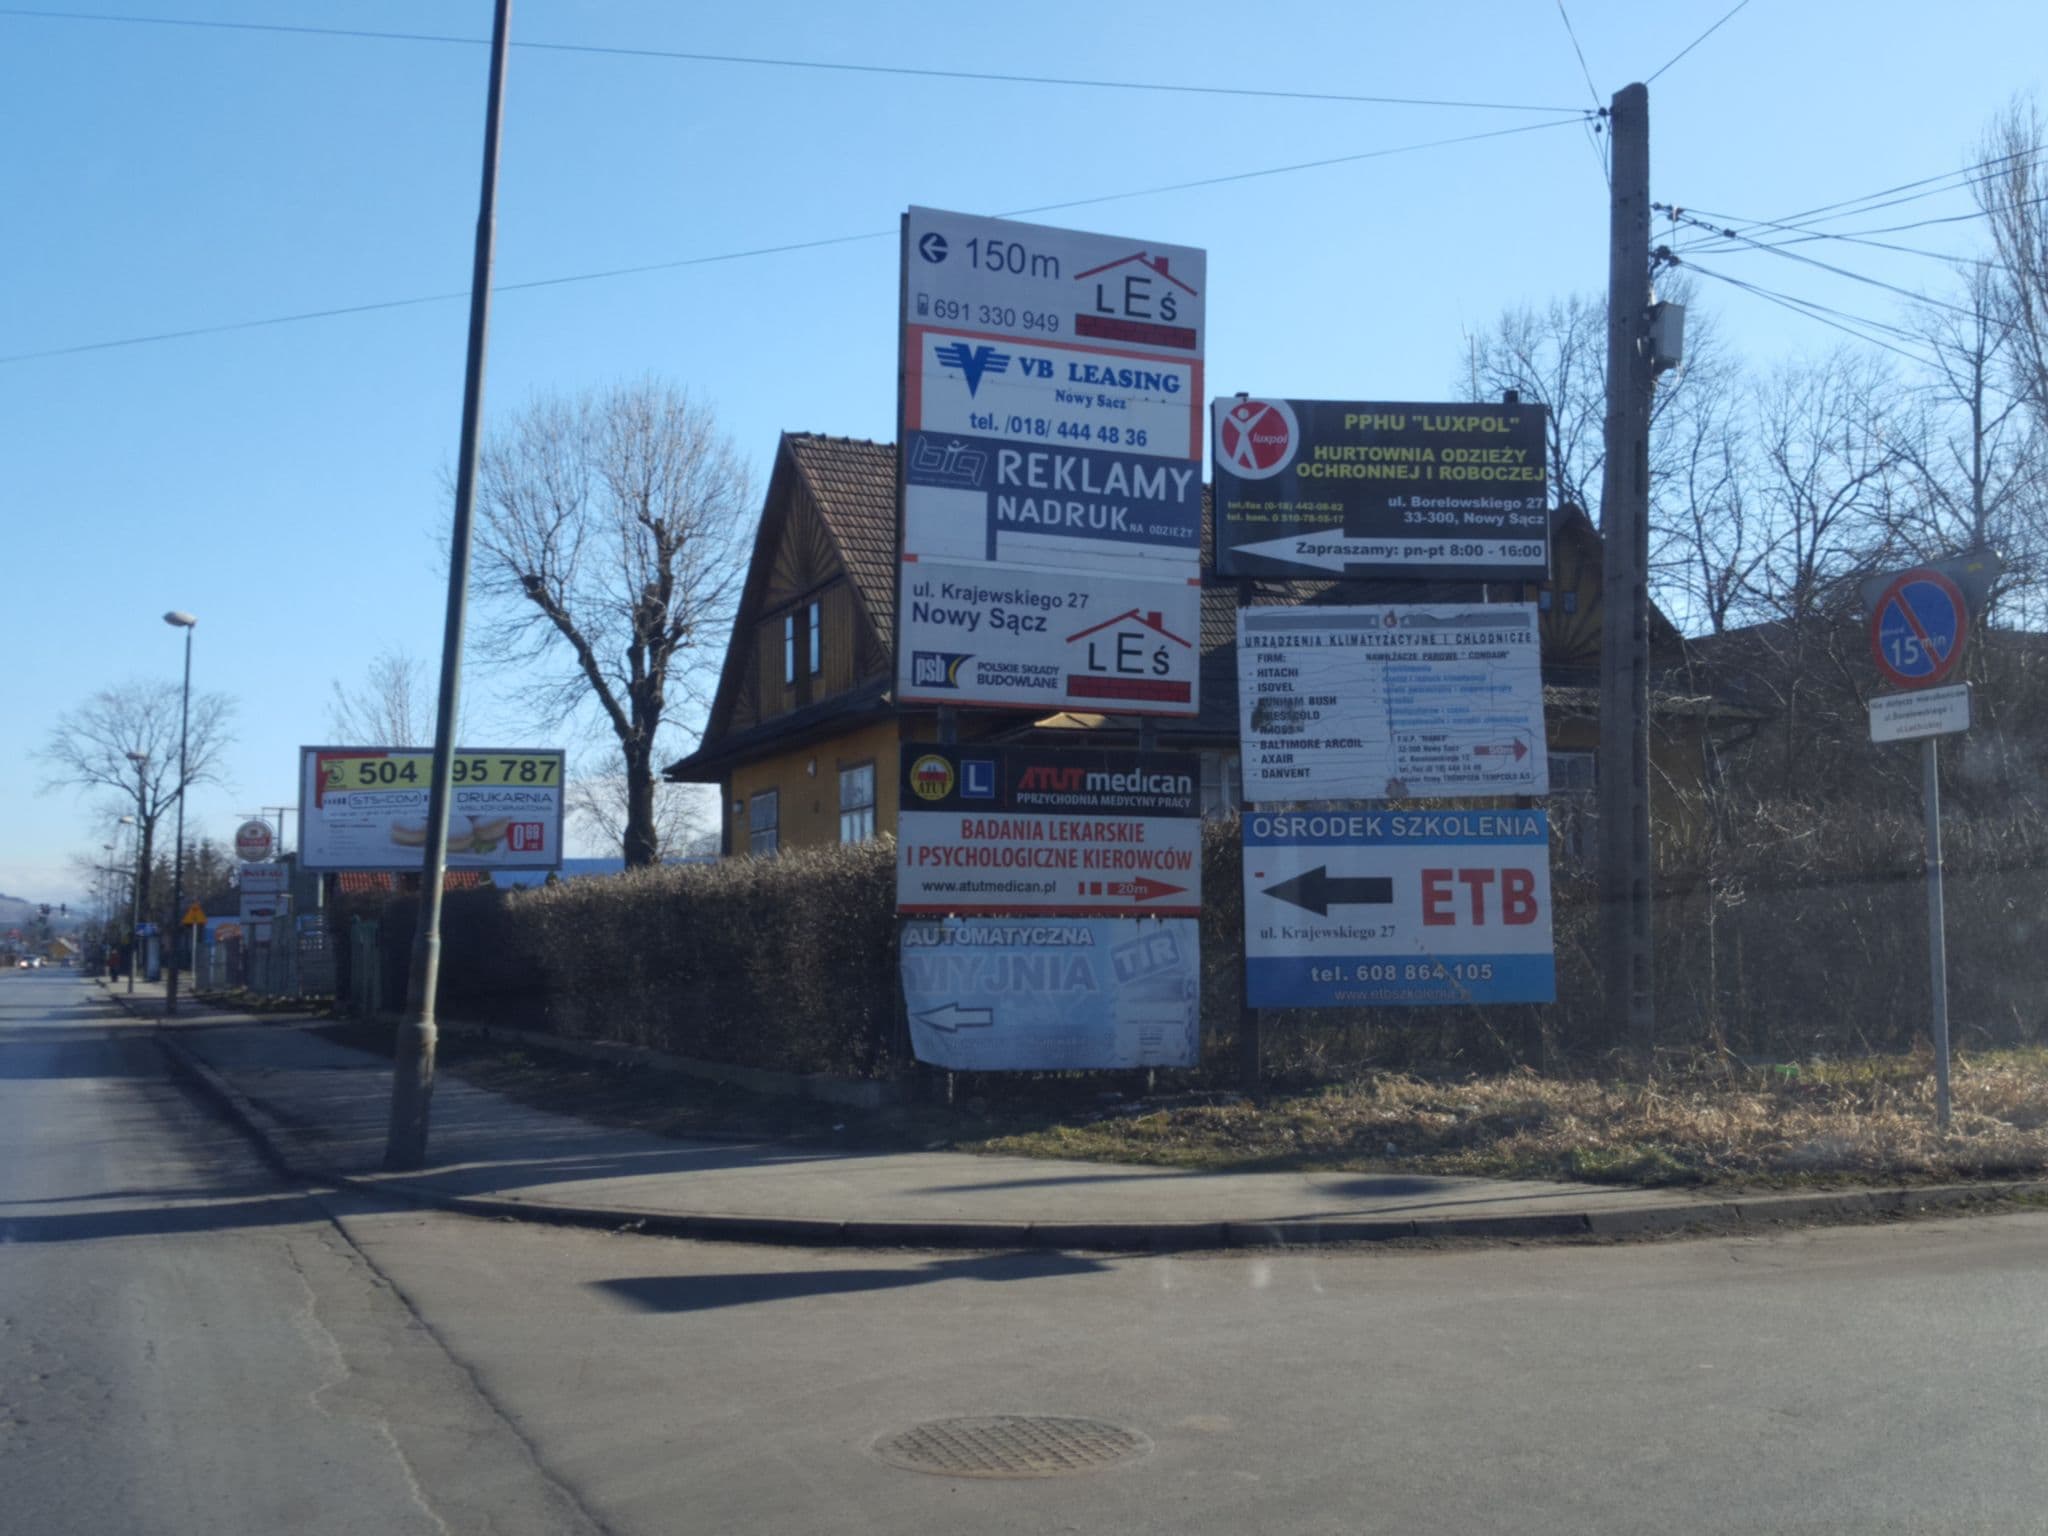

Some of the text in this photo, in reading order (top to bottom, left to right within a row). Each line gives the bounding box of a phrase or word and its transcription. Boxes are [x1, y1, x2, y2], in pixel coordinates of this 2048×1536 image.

[1096, 275, 1178, 322] LEŚ
[934, 299, 1060, 333] 691 330 949
[1019, 356, 1181, 394] VB LEASING
[1055, 389, 1093, 409] Nowy
[970, 412, 1148, 447] tel. /018/ 444 48 36
[1344, 413, 1520, 433] PPHU "LUXPOL"
[1252, 431, 1288, 446] luxpol
[1314, 445, 1527, 465] HURTOWNIA ODZIEŻY
[997, 449, 1193, 503] REKLAMY
[1296, 463, 1544, 481] OCHRONNEJ I ROBOCZEJ
[1388, 495, 1544, 511] ul. Borelowskiego 27
[997, 496, 1129, 532] NADRUK
[1129, 522, 1144, 534] NA
[1404, 512, 1545, 528] 33-300, Nowy Sącz
[1296, 541, 1399, 558] Zapraszamy:
[1403, 543, 1444, 559] pn-pt
[1450, 544, 1484, 557] 8:00
[1499, 544, 1542, 558] 16:00
[913, 580, 1089, 611] ul. Krajewskiego 27
[912, 602, 1048, 636] Nowy Sącz
[1245, 634, 1322, 649] URZĄDZENIA
[1329, 632, 1437, 648] KLIMATYZACYJNE
[1891, 634, 1947, 666] 15 min
[1088, 631, 1170, 676] LEŚ
[1257, 653, 1287, 664] FIRM:
[915, 653, 948, 685] psb
[977, 661, 1060, 676] POLSKIE SKŁADY
[1257, 667, 1299, 678] HITACHI
[976, 673, 1059, 689] BUDOWLANE
[1257, 682, 1295, 693] ISOVEL
[1308, 695, 1337, 706] BUSH
[1260, 738, 1363, 750] BALTIMORE ARCOIL
[1261, 754, 1294, 765] AXAIR
[359, 760, 418, 785] 504
[502, 760, 557, 783] 787
[968, 763, 988, 793] L
[1261, 768, 1310, 779] DANVENT
[456, 792, 553, 803] DRUKARNIA
[1100, 795, 1156, 808] MEDYCYNY
[1158, 797, 1192, 809] PRACY
[961, 818, 1145, 843] BADANIA LEKARSKIE
[1391, 815, 1539, 837] SZKOLENIA
[907, 846, 1192, 871] I PSYCHOLOGICZNE KIEROWCÓW
[921, 877, 1057, 894] www.atutmedican.pl
[1421, 868, 1538, 926] ETB
[905, 927, 1094, 948] AUTOMATYCZNA
[1260, 925, 1396, 942] ul. Krajewskiego 27
[1115, 934, 1178, 978] TIR
[904, 952, 1100, 993] MYJNIA
[1311, 963, 1492, 982] tel. 608 864 105
